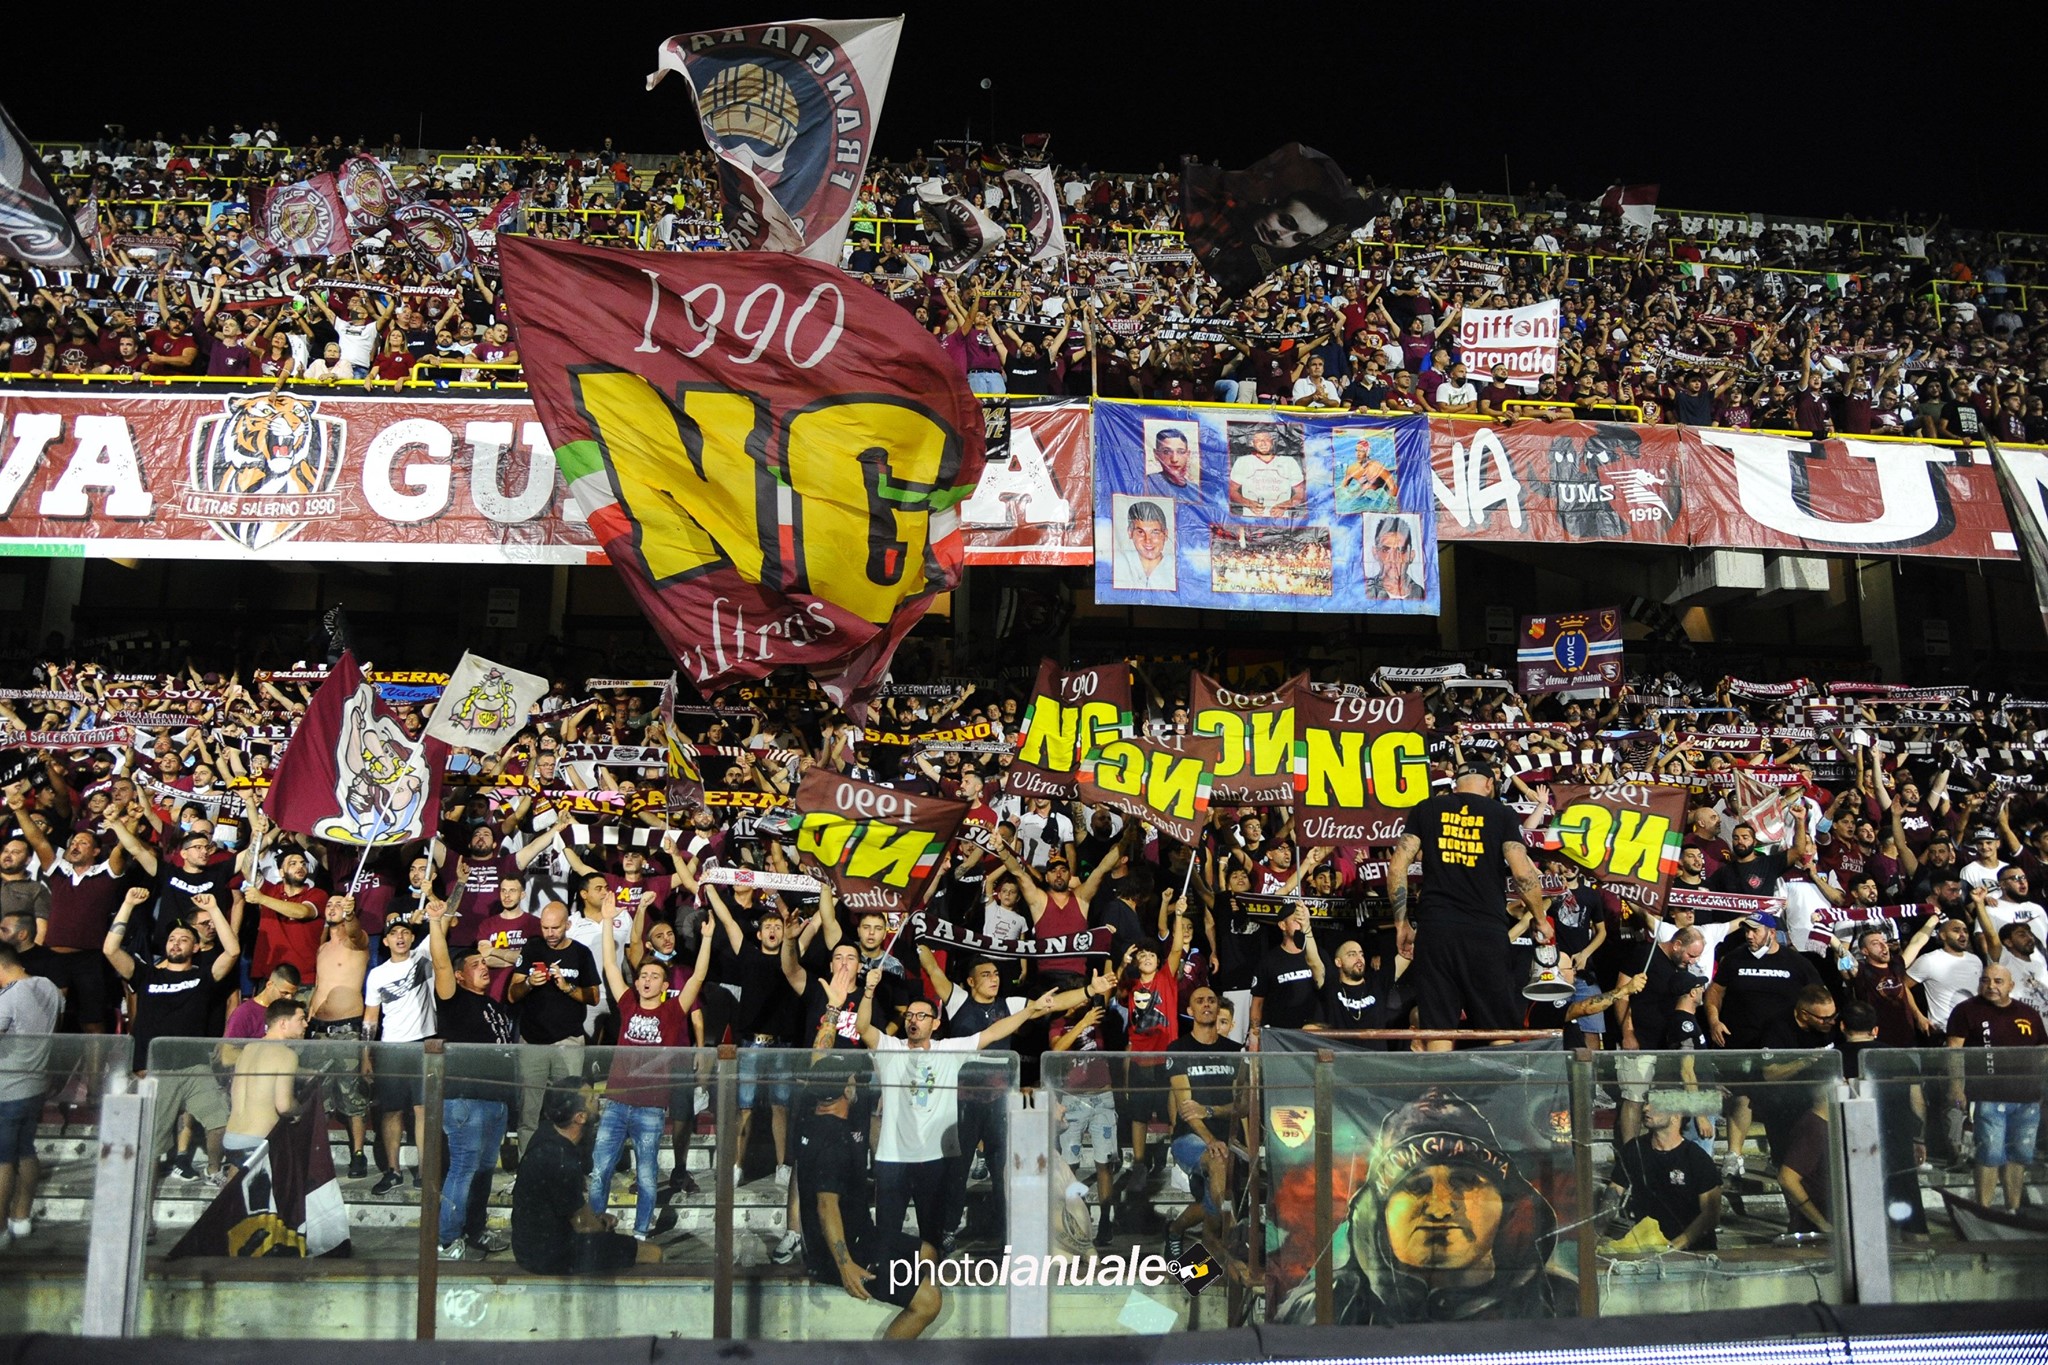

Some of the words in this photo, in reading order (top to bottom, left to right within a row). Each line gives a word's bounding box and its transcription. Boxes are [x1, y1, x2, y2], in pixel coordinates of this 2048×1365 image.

[634, 267, 845, 370] 1990
[572, 368, 955, 625] NG
[1558, 482, 1616, 504] UMS
[186, 495, 236, 515] ULTRAS
[240, 496, 300, 517] SALERNO
[303, 496, 335, 515] 1990
[1628, 506, 1662, 522] 1919
[892, 685, 952, 696] SALERNITANA
[1329, 696, 1404, 725] 1990
[31, 729, 115, 743] SALERNITANA
[864, 721, 991, 746] SALERNO
[1018, 694, 1120, 772] NG
[1740, 725, 1758, 735] SUD
[1305, 727, 1430, 808] NG
[1012, 771, 1065, 798] Ultras
[1658, 774, 1708, 788] SUD
[1441, 811, 1485, 827] DIFESA
[1302, 816, 1365, 840] Ultras
[1442, 824, 1481, 840] DELLA
[1438, 837, 1485, 854] NOSTRA
[169, 877, 214, 894] SALERNO
[1686, 894, 1759, 909] SALERNITANA
[2014, 910, 2033, 921] NIKE
[1737, 968, 1791, 979] SALERNO
[148, 978, 201, 994] SALERNO
[1186, 1064, 1236, 1077] SALERNO
